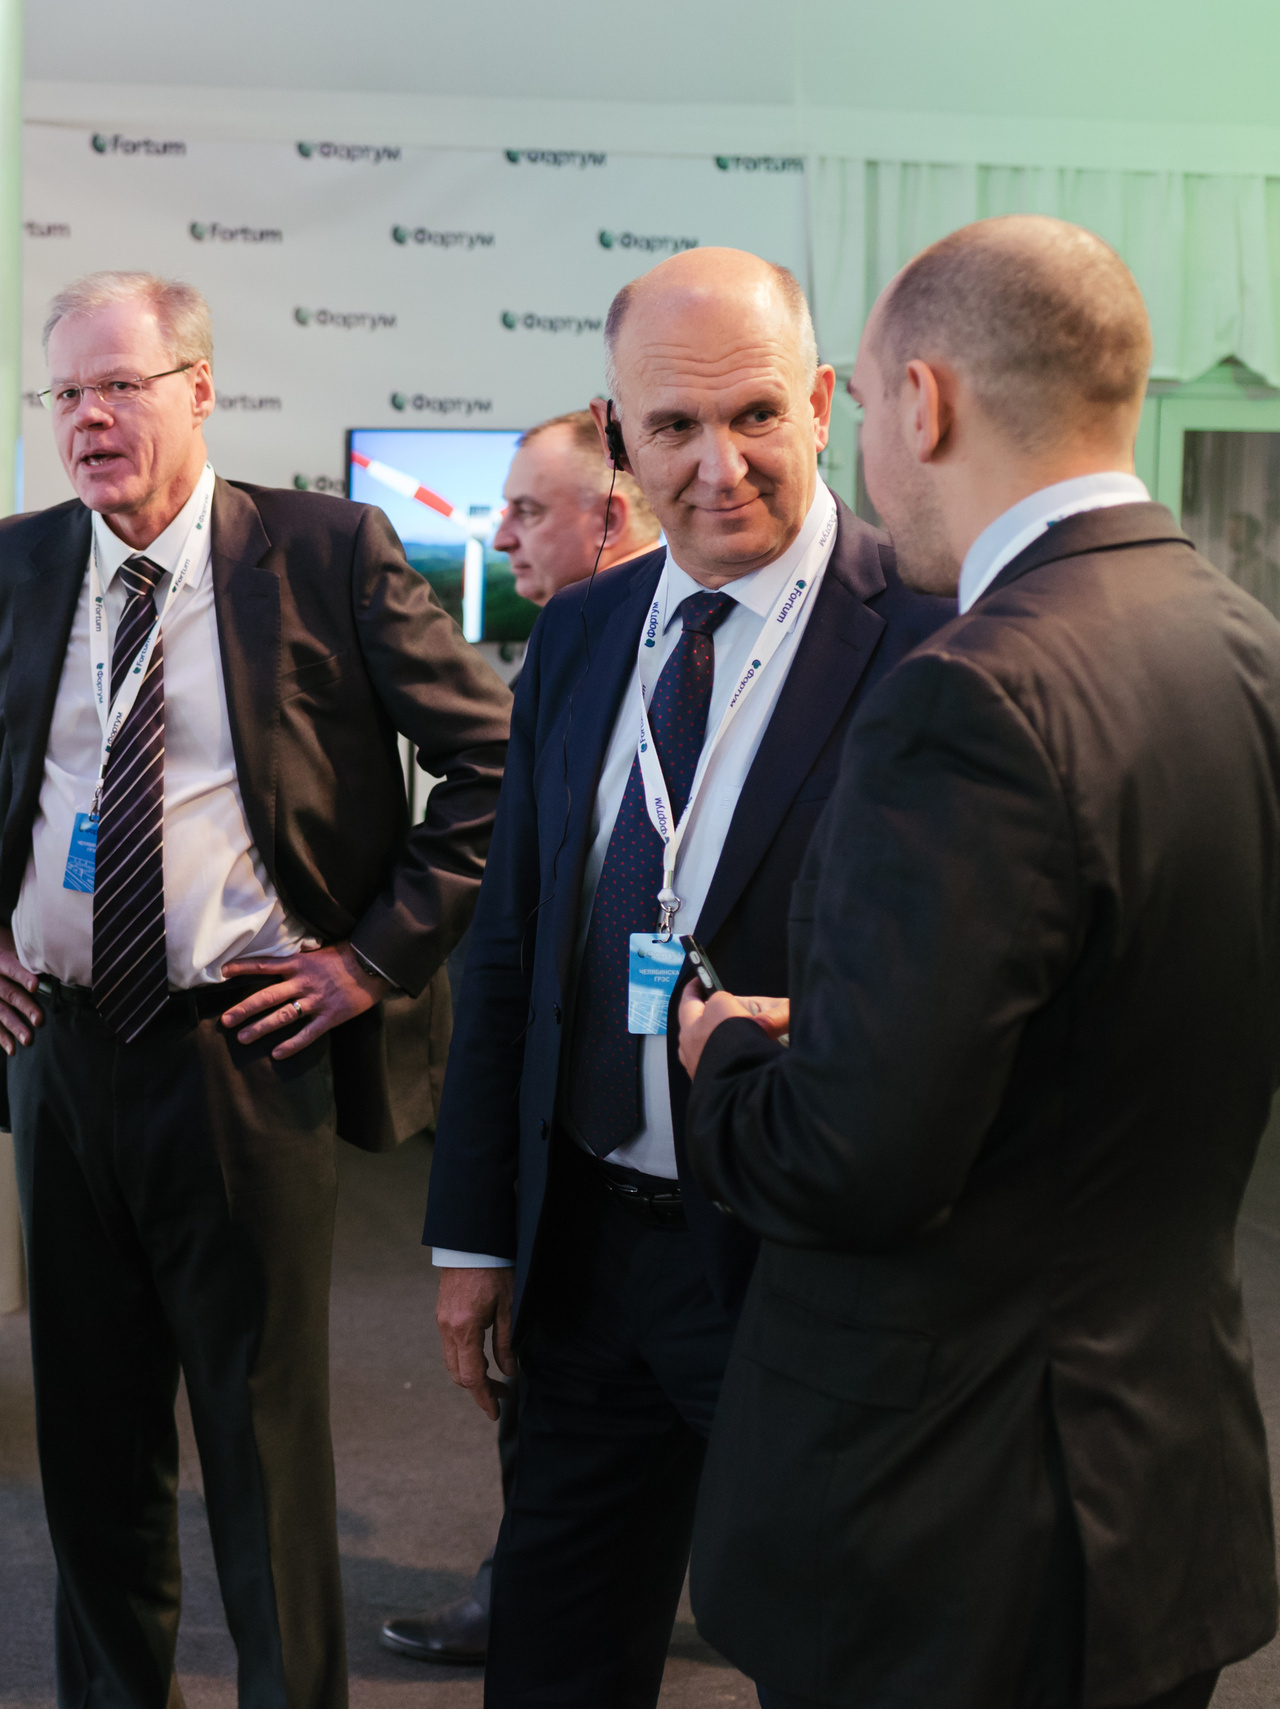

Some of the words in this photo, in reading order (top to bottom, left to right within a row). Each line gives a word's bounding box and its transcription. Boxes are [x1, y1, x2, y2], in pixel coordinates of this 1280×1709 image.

[648, 601, 659, 638] Фортум
[776, 586, 803, 624] Fortum
[729, 668, 756, 708] Фортум
[654, 796, 668, 836] Фортум
